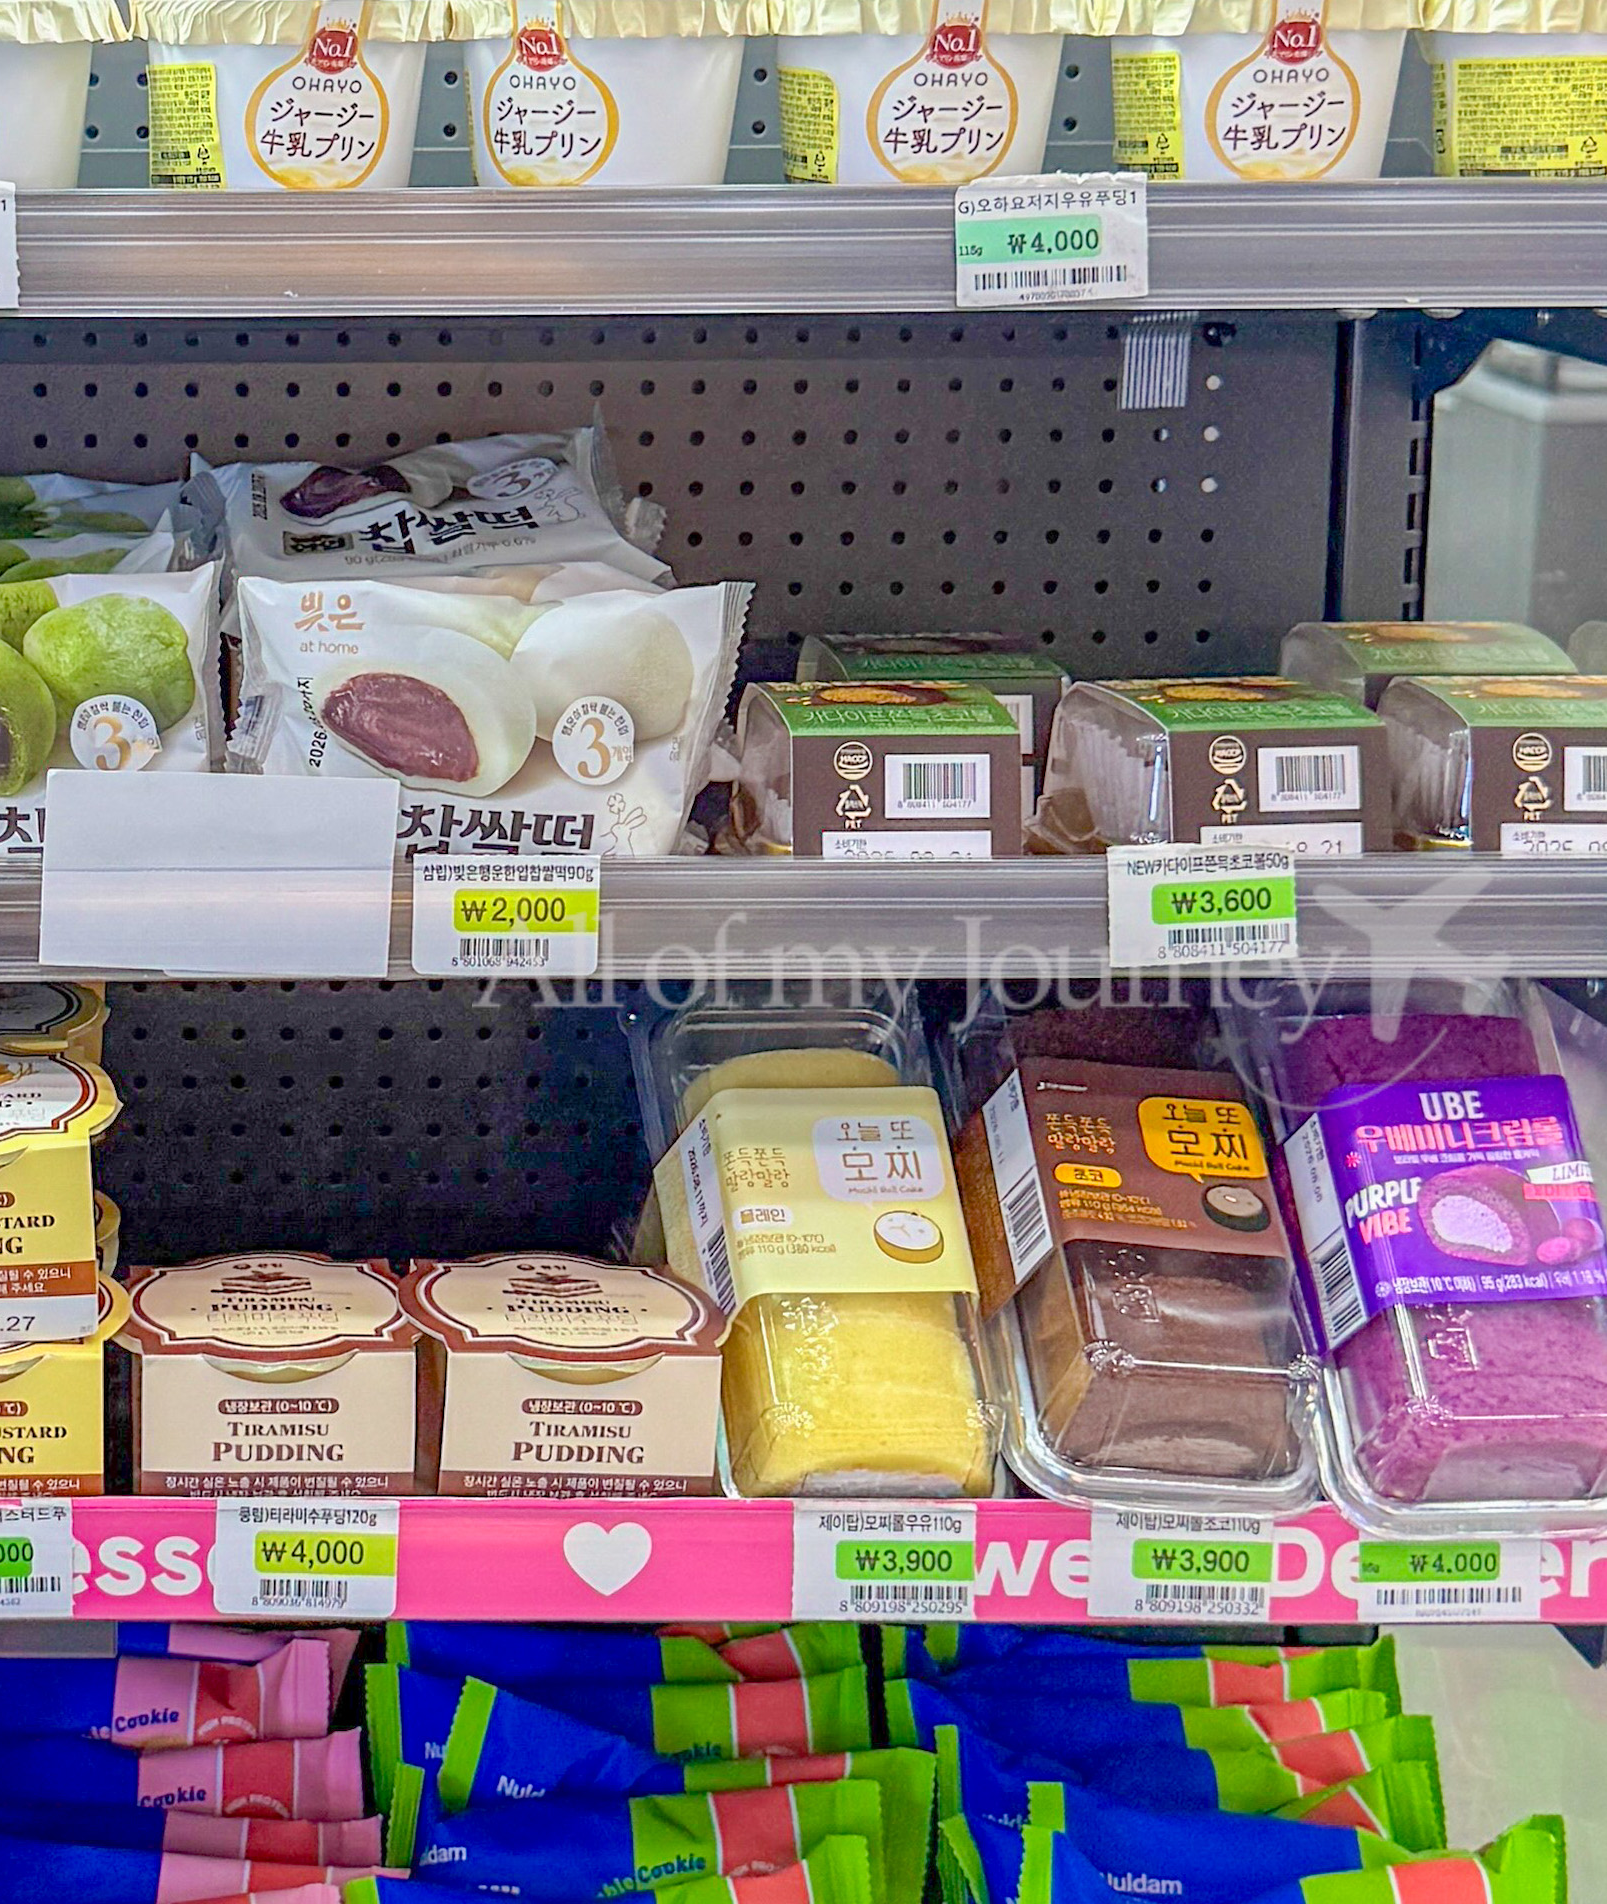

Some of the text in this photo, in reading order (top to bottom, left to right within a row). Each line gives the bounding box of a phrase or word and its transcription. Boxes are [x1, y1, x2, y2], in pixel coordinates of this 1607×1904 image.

[914, 71, 988, 87] OHAYO
[1253, 68, 1330, 84] OHAYO
[893, 95, 1004, 120] ジャージー
[1232, 92, 1344, 118] ジャージー
[884, 125, 1007, 154] 牛乳プリン
[1224, 122, 1346, 152] 牛乳プリン
[295, 591, 366, 632] 빚은
[300, 641, 358, 655] at home
[1420, 1091, 1484, 1122] UBE
[837, 1121, 914, 1144] 오늘 또
[1356, 1116, 1564, 1153] 우베미니크림롤
[842, 1146, 922, 1182] 모찌
[1358, 1212, 1413, 1244] VIBE
[228, 1421, 330, 1438] TIRAMISU
[212, 1441, 344, 1464] PUDDING
